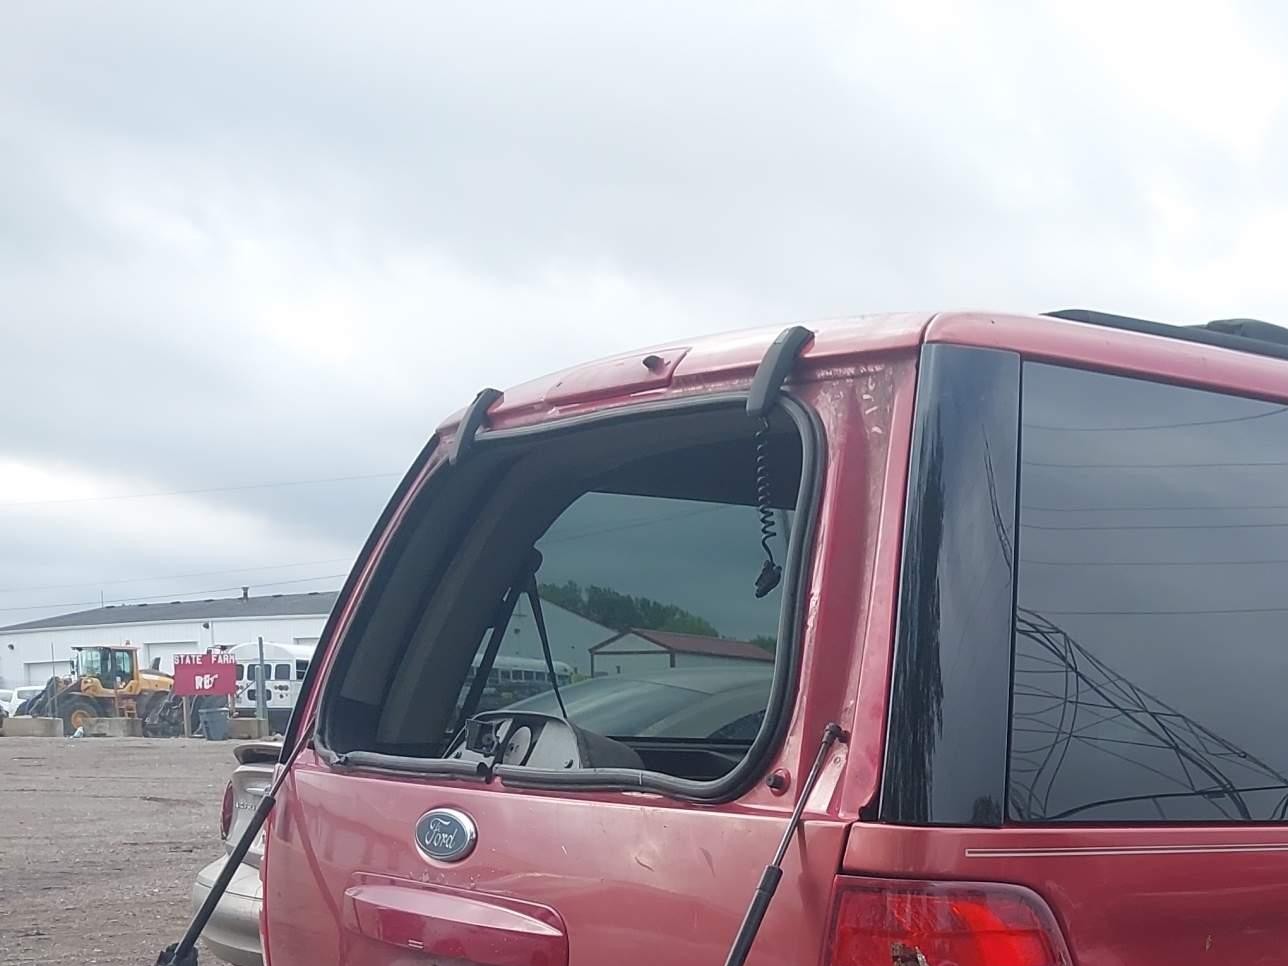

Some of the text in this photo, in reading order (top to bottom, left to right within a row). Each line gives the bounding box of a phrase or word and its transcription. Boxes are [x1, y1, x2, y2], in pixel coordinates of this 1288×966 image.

[174, 654, 235, 665] STATE FARM
[424, 817, 459, 849] Ford
